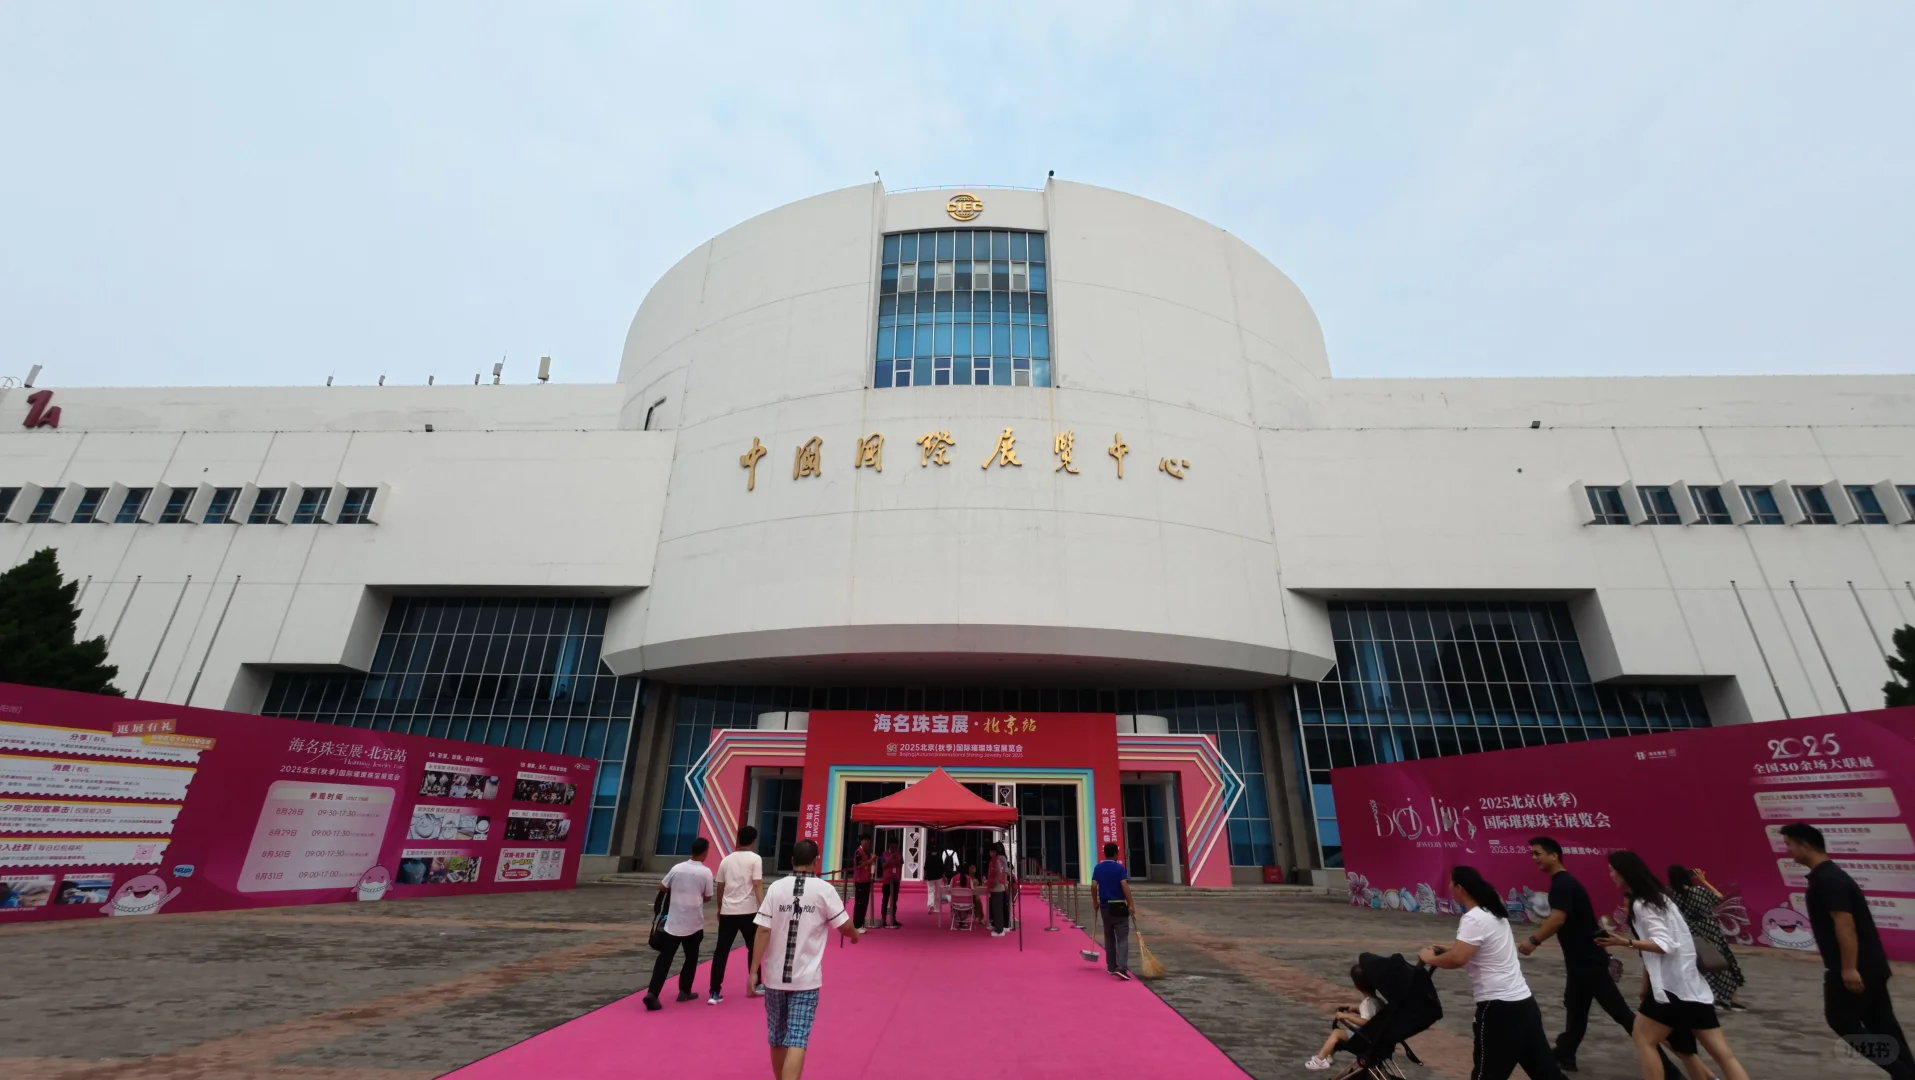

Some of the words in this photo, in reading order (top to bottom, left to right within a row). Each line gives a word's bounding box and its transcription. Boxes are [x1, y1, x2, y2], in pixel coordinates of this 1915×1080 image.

[946, 201, 983, 213] CIEC
[22, 390, 62, 429] 1A
[116, 720, 173, 735] 逛展有礼
[873, 713, 1037, 736] 海名珠宝展·北京站
[1767, 733, 1841, 760] 2025
[1753, 755, 1875, 774] 全国30余场大联展
[1479, 792, 1578, 810] 2025北京(秋季)
[812, 804, 821, 838] WELCOME
[1109, 807, 1118, 843] WELCOME
[1483, 812, 1611, 830] 国际璀璨珠宝展览会
[268, 828, 298, 837] 8月29日
[261, 849, 291, 858] 8月30日
[255, 871, 284, 881] 8月31日
[778, 904, 793, 913] RALPH
[803, 905, 816, 914] POLO
